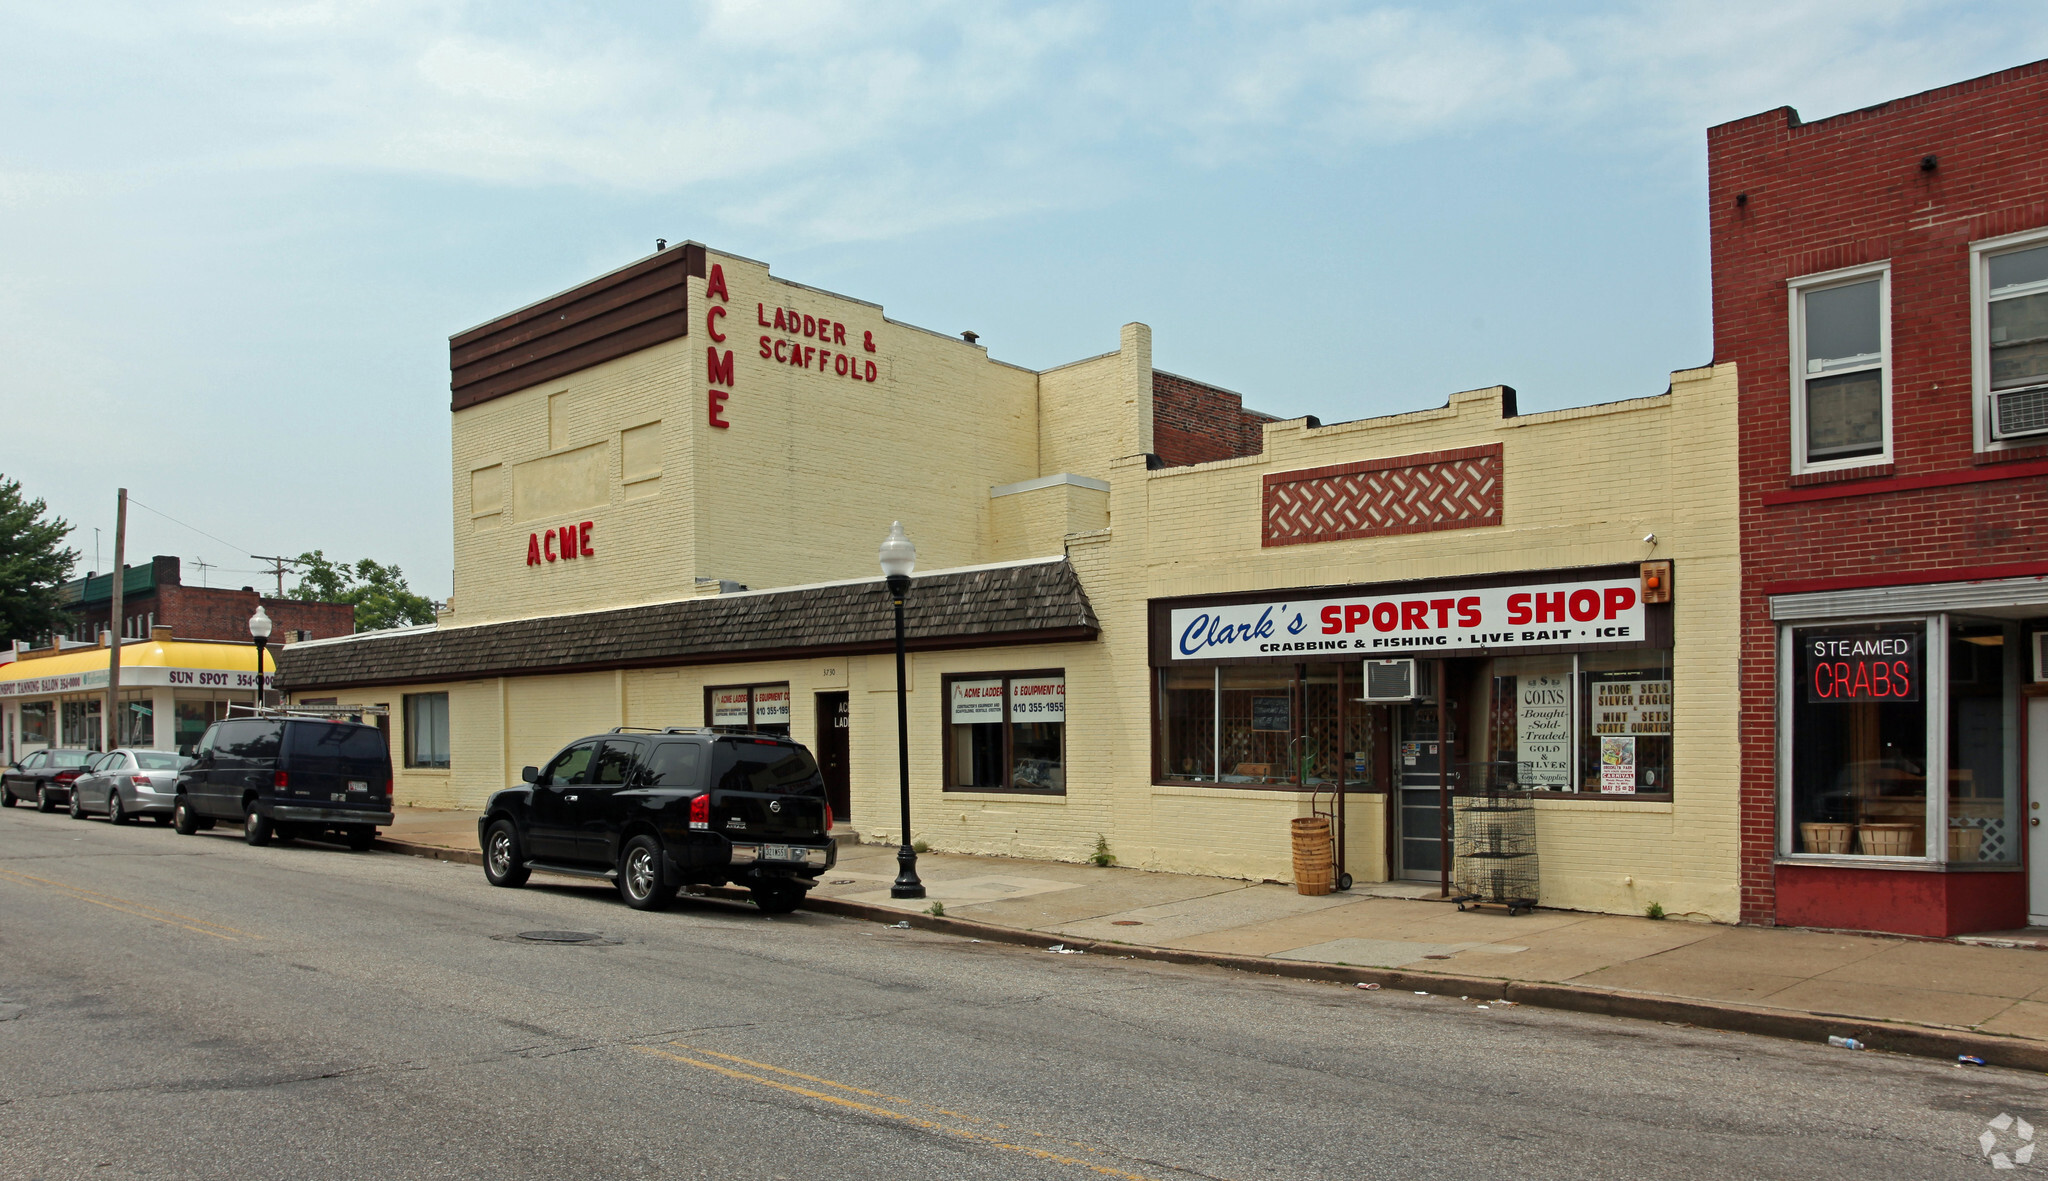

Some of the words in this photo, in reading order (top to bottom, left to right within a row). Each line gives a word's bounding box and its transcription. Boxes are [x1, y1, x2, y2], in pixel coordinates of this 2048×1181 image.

[757, 303, 846, 346] LADDER
[863, 330, 877, 353] &
[706, 264, 734, 429] ACME
[759, 336, 878, 382] SCAFFOLD
[527, 521, 594, 566] ACME
[1179, 604, 1307, 655] Clark's
[1320, 597, 1482, 635] SPORTS
[1507, 587, 1636, 625] SHOP
[1260, 640, 1348, 653] CRABBING
[1354, 639, 1366, 649] &
[1373, 635, 1447, 648] FISHING
[1470, 632, 1514, 644] LIVE
[1522, 629, 1572, 641] BAIT
[1596, 627, 1630, 638] ICE
[1814, 638, 1909, 657] STEAMED
[169, 671, 194, 684] SUN
[200, 673, 228, 685] SPOT
[1815, 661, 1910, 698] CRABS
[17, 681, 40, 694] TANNING
[42, 678, 59, 692] SALON
[964, 688, 980, 698] ACME
[1014, 686, 1018, 696] &
[1020, 685, 1055, 696] EQUIPMENT
[1600, 684, 1631, 695] PROOF
[1641, 683, 1668, 694] SETS
[721, 695, 732, 704] ACME
[733, 694, 748, 703] LADDE
[760, 692, 783, 702] EQUIPMENT
[1524, 690, 1565, 705] COINS
[1598, 695, 1634, 706] SILVER
[1639, 694, 1670, 705] EAGLE
[756, 707, 765, 715] 410
[767, 706, 789, 715] 355-195
[838, 702, 849, 713] AC
[1013, 703, 1027, 713] 410
[1028, 702, 1064, 713] 355-1955
[834, 716, 849, 728] LAD
[1603, 712, 1627, 722] MINT
[1642, 711, 1669, 721] SETS
[1597, 723, 1626, 733] STATE
[1529, 745, 1560, 753] GOLD
[1523, 761, 1567, 769] SILVER
[1539, 773, 1568, 782] Supplies
